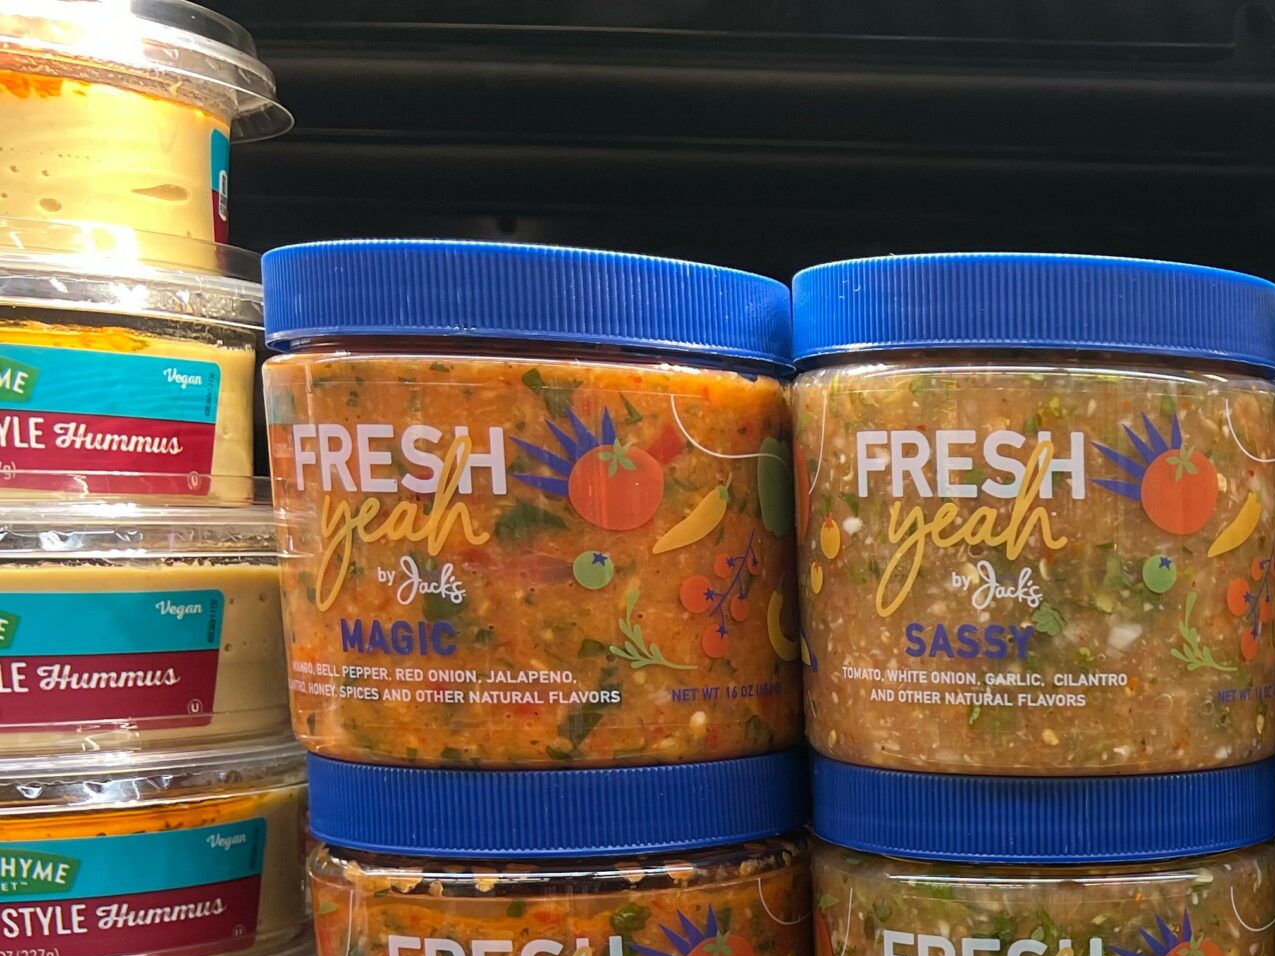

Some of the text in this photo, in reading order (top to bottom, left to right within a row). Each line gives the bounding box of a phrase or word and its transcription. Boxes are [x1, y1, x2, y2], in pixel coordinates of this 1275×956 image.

[163, 368, 202, 387] Vegan
[54, 422, 183, 456] Hummus
[292, 423, 507, 495] FRESH
[856, 429, 1085, 499] FRESH
[316, 435, 490, 612] yeah
[876, 439, 1068, 618] yeah
[377, 556, 466, 604] by Jack's
[952, 560, 1043, 610] by Jack's
[340, 618, 457, 656] MAGIC
[905, 623, 1034, 660] SASSY
[37, 664, 180, 689] Hummus
[887, 669, 927, 684] WHITE
[1054, 673, 1128, 687] CILANTRO
[870, 688, 1086, 707] AND OTHER NATURAL FLAVORS
[206, 832, 246, 851] Vegan
[2, 897, 227, 938] STYLE Hummus
